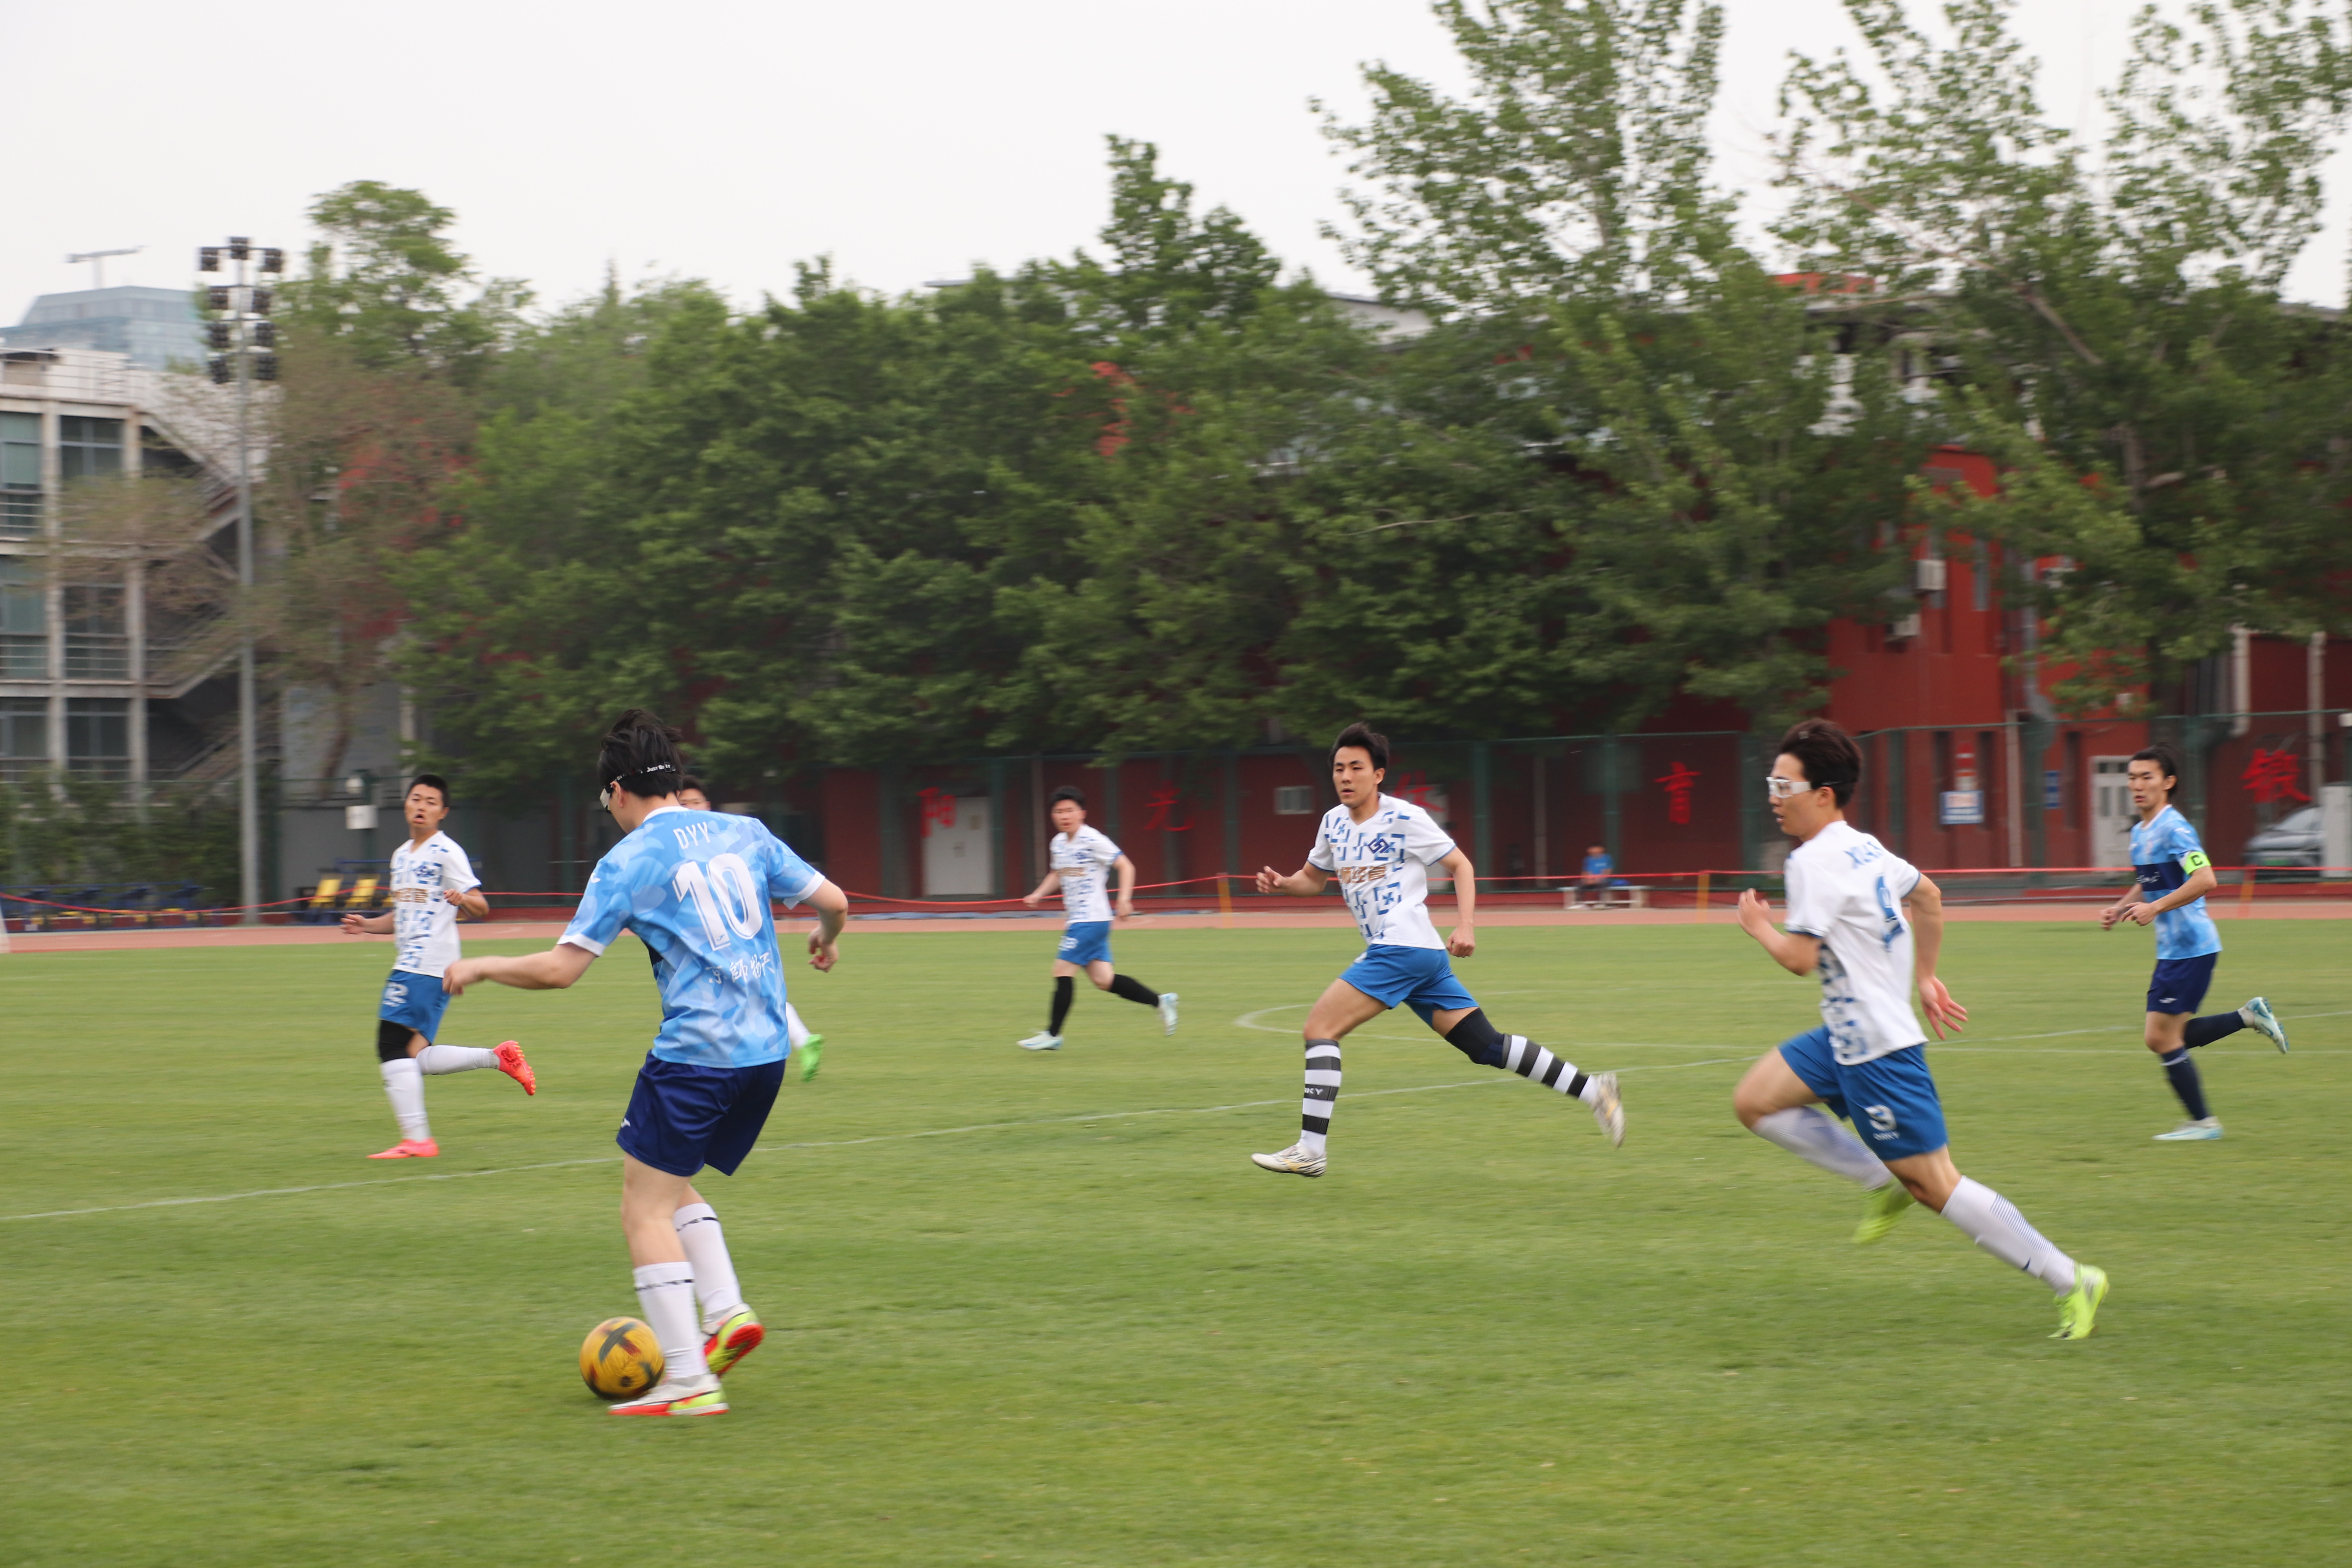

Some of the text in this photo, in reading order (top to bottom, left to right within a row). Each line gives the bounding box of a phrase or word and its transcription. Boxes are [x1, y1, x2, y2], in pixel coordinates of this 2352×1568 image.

[673, 822, 711, 849] DYY
[2191, 855, 2203, 866] C
[672, 853, 762, 951] 10
[1864, 1105, 1896, 1132] 9
